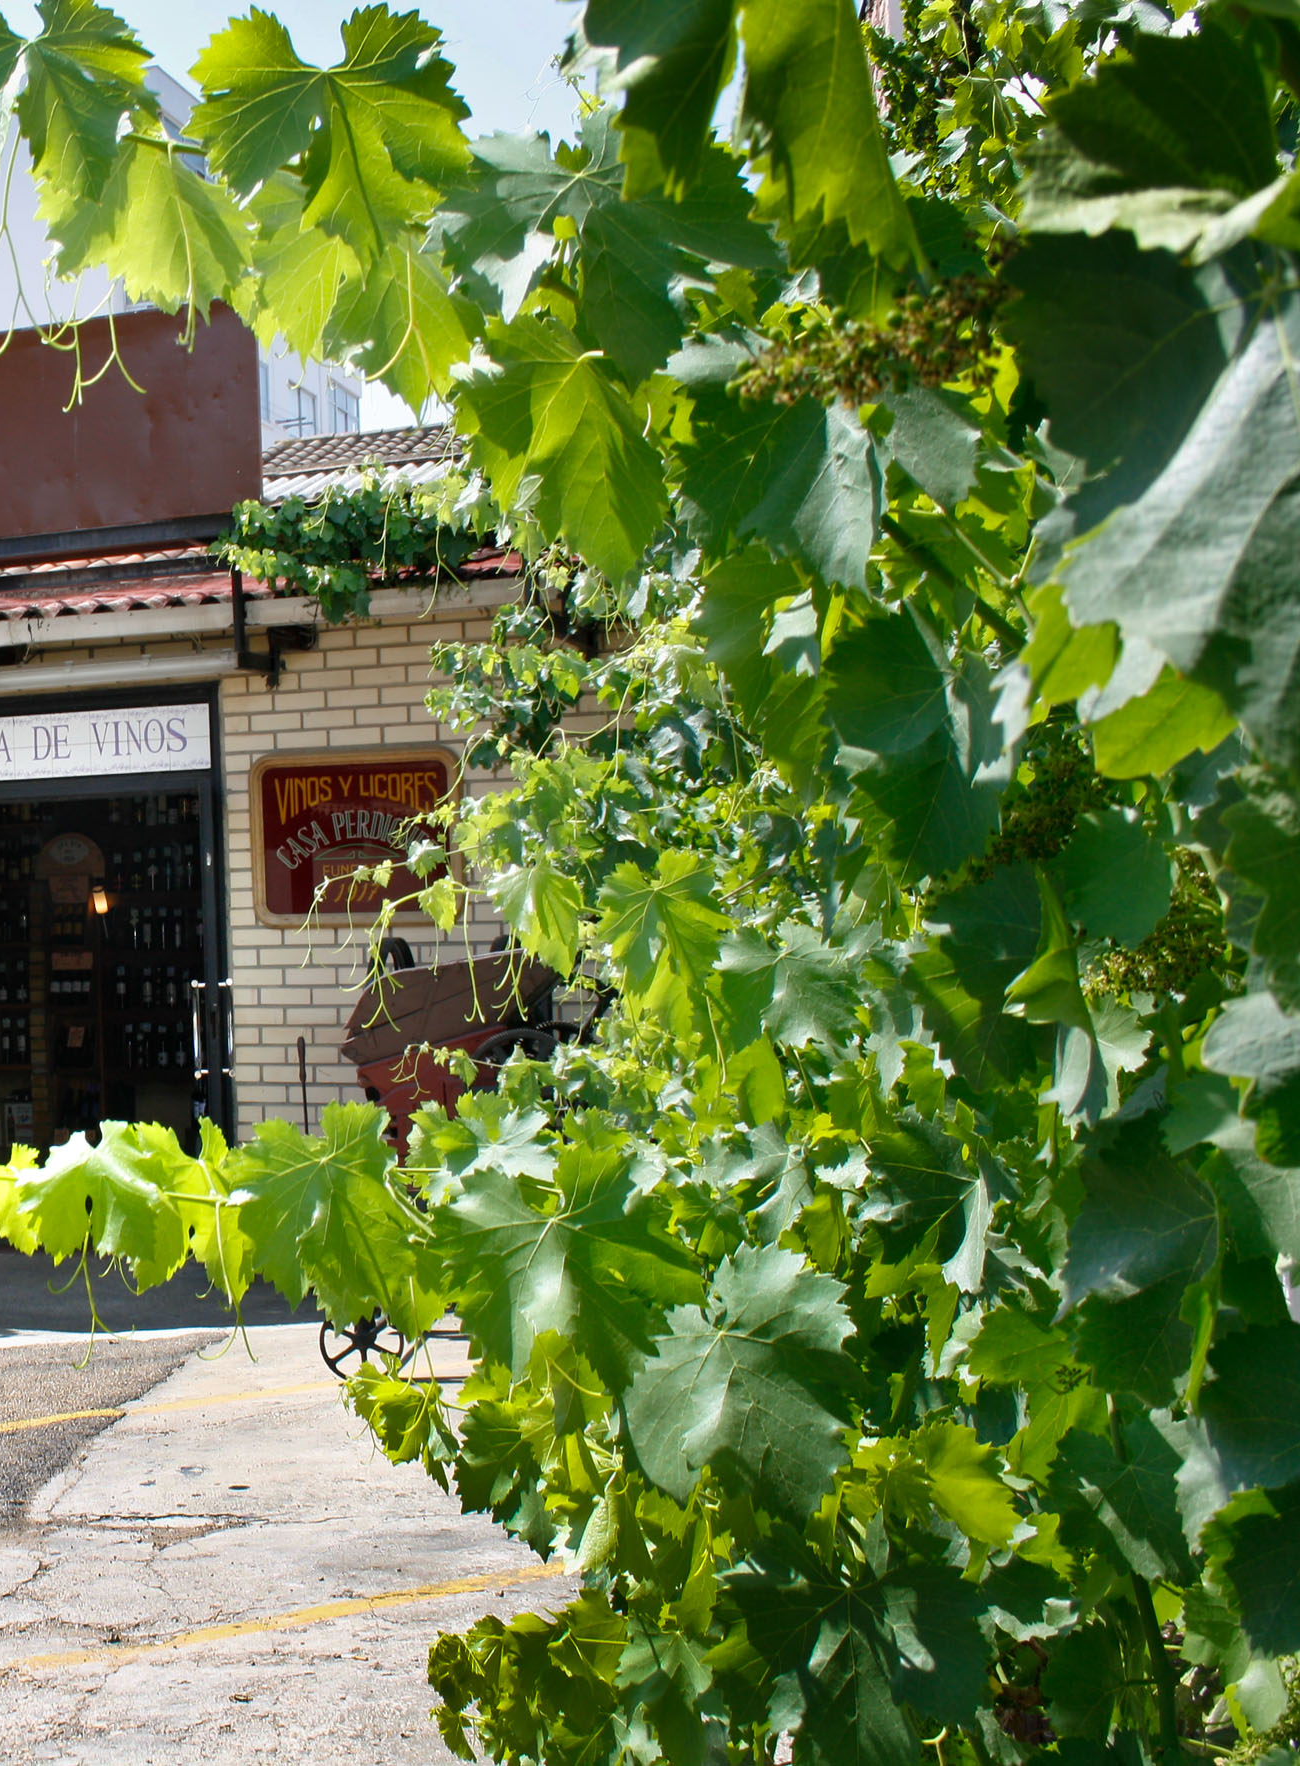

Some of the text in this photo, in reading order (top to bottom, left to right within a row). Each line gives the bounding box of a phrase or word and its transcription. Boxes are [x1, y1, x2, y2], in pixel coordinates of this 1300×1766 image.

[32, 724, 71, 761] DE
[91, 717, 188, 756] VINOS
[275, 772, 438, 825] VINOS Y LICORES
[276, 821, 330, 870] CASA
